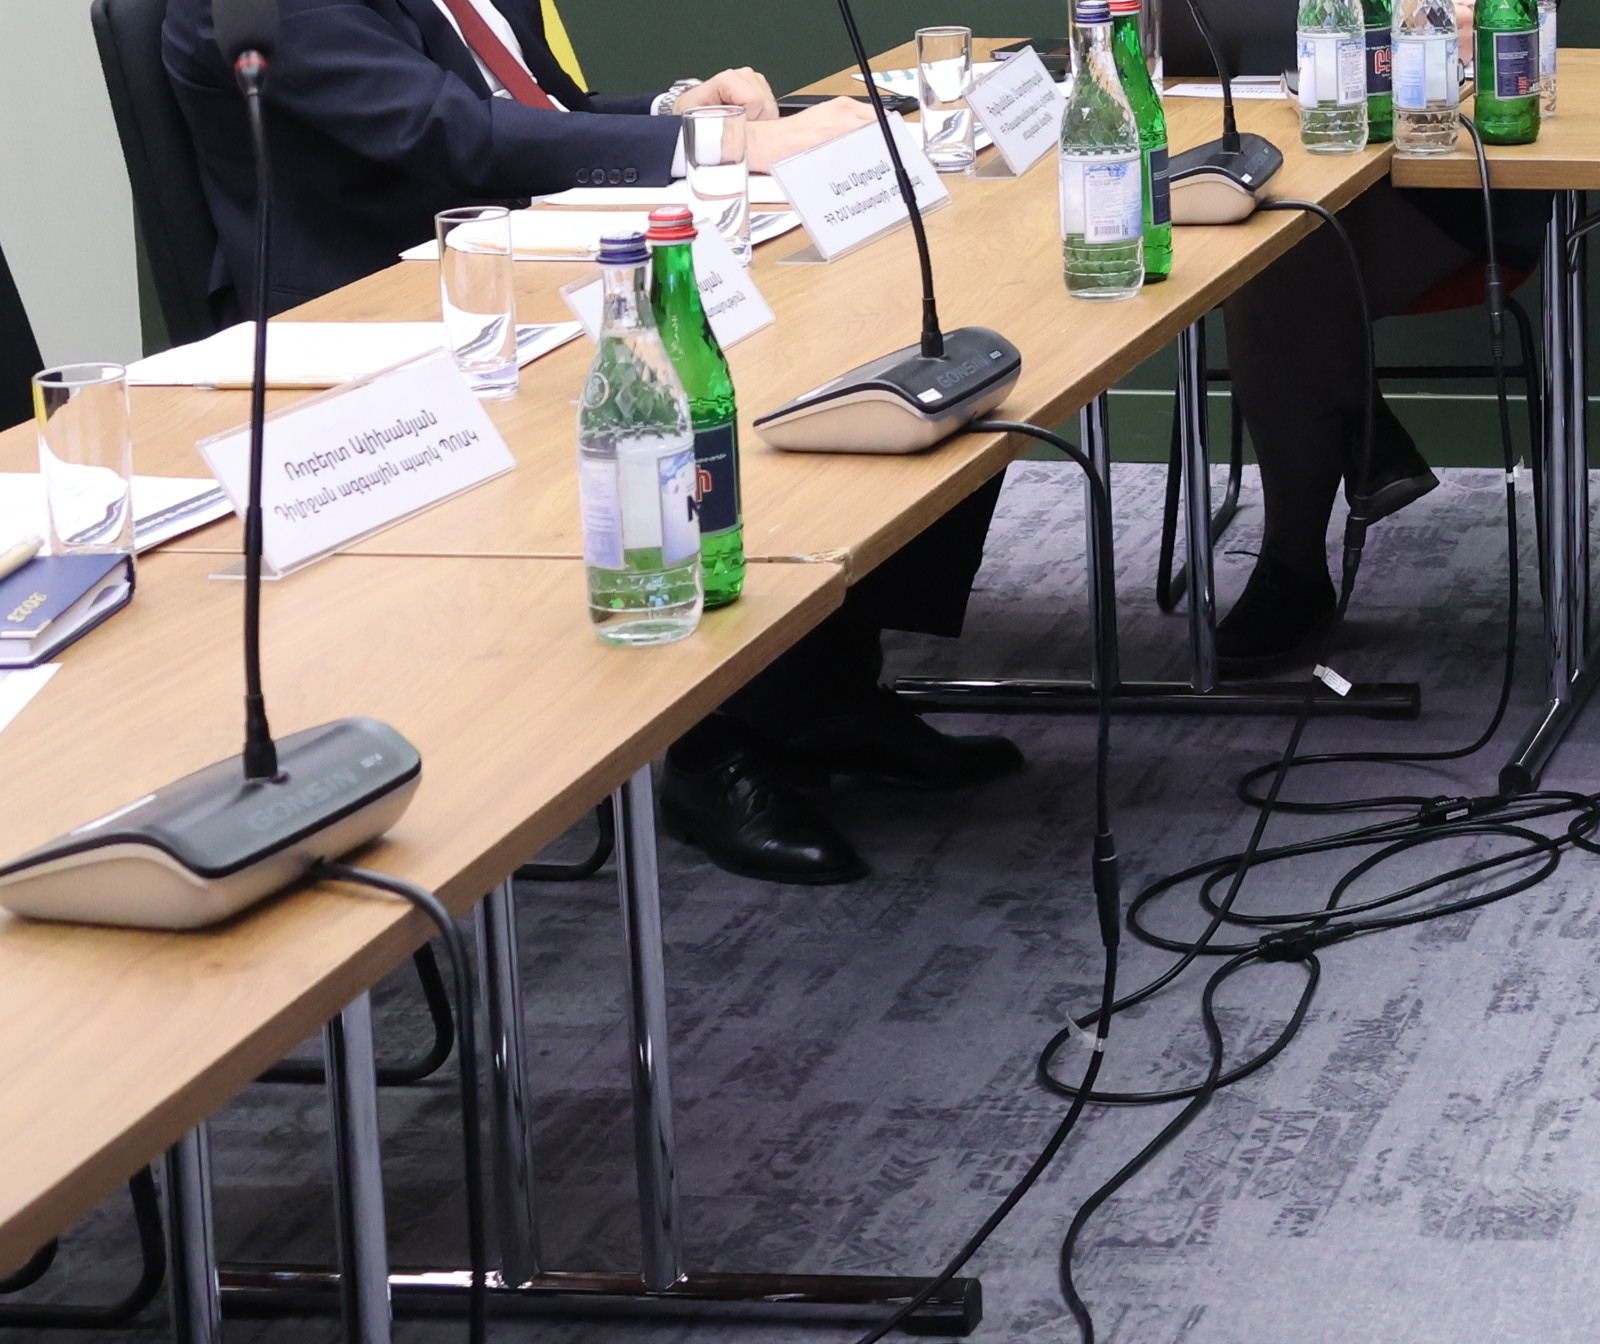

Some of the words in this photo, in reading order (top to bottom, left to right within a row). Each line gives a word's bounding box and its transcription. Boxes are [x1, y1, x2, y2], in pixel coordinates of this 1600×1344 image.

[274, 486, 337, 522] Դիլիջան
[337, 460, 400, 499] ազգային
[400, 441, 443, 472] պարկ
[438, 429, 481, 457] ՊՈԱԿ
[283, 443, 351, 481] Ռոբերտ
[348, 409, 438, 455] Ալիխանյան
